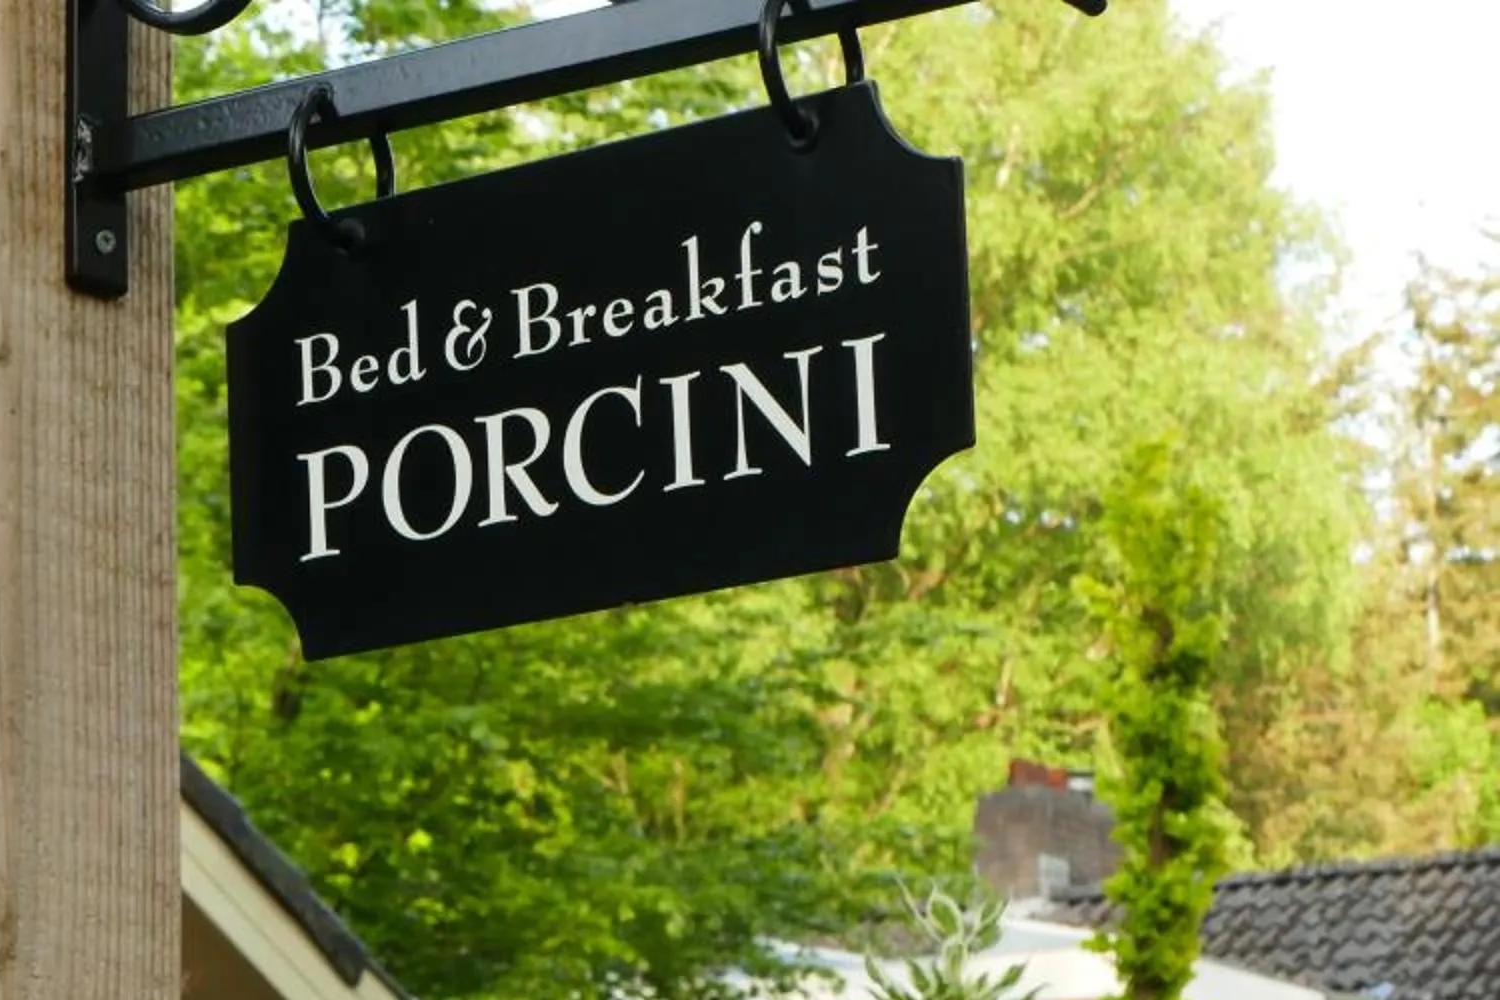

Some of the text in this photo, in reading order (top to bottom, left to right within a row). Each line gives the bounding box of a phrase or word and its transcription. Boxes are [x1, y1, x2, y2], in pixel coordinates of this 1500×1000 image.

[295, 220, 881, 406] Bed & Breakfast
[296, 332, 891, 562] PORCINI
